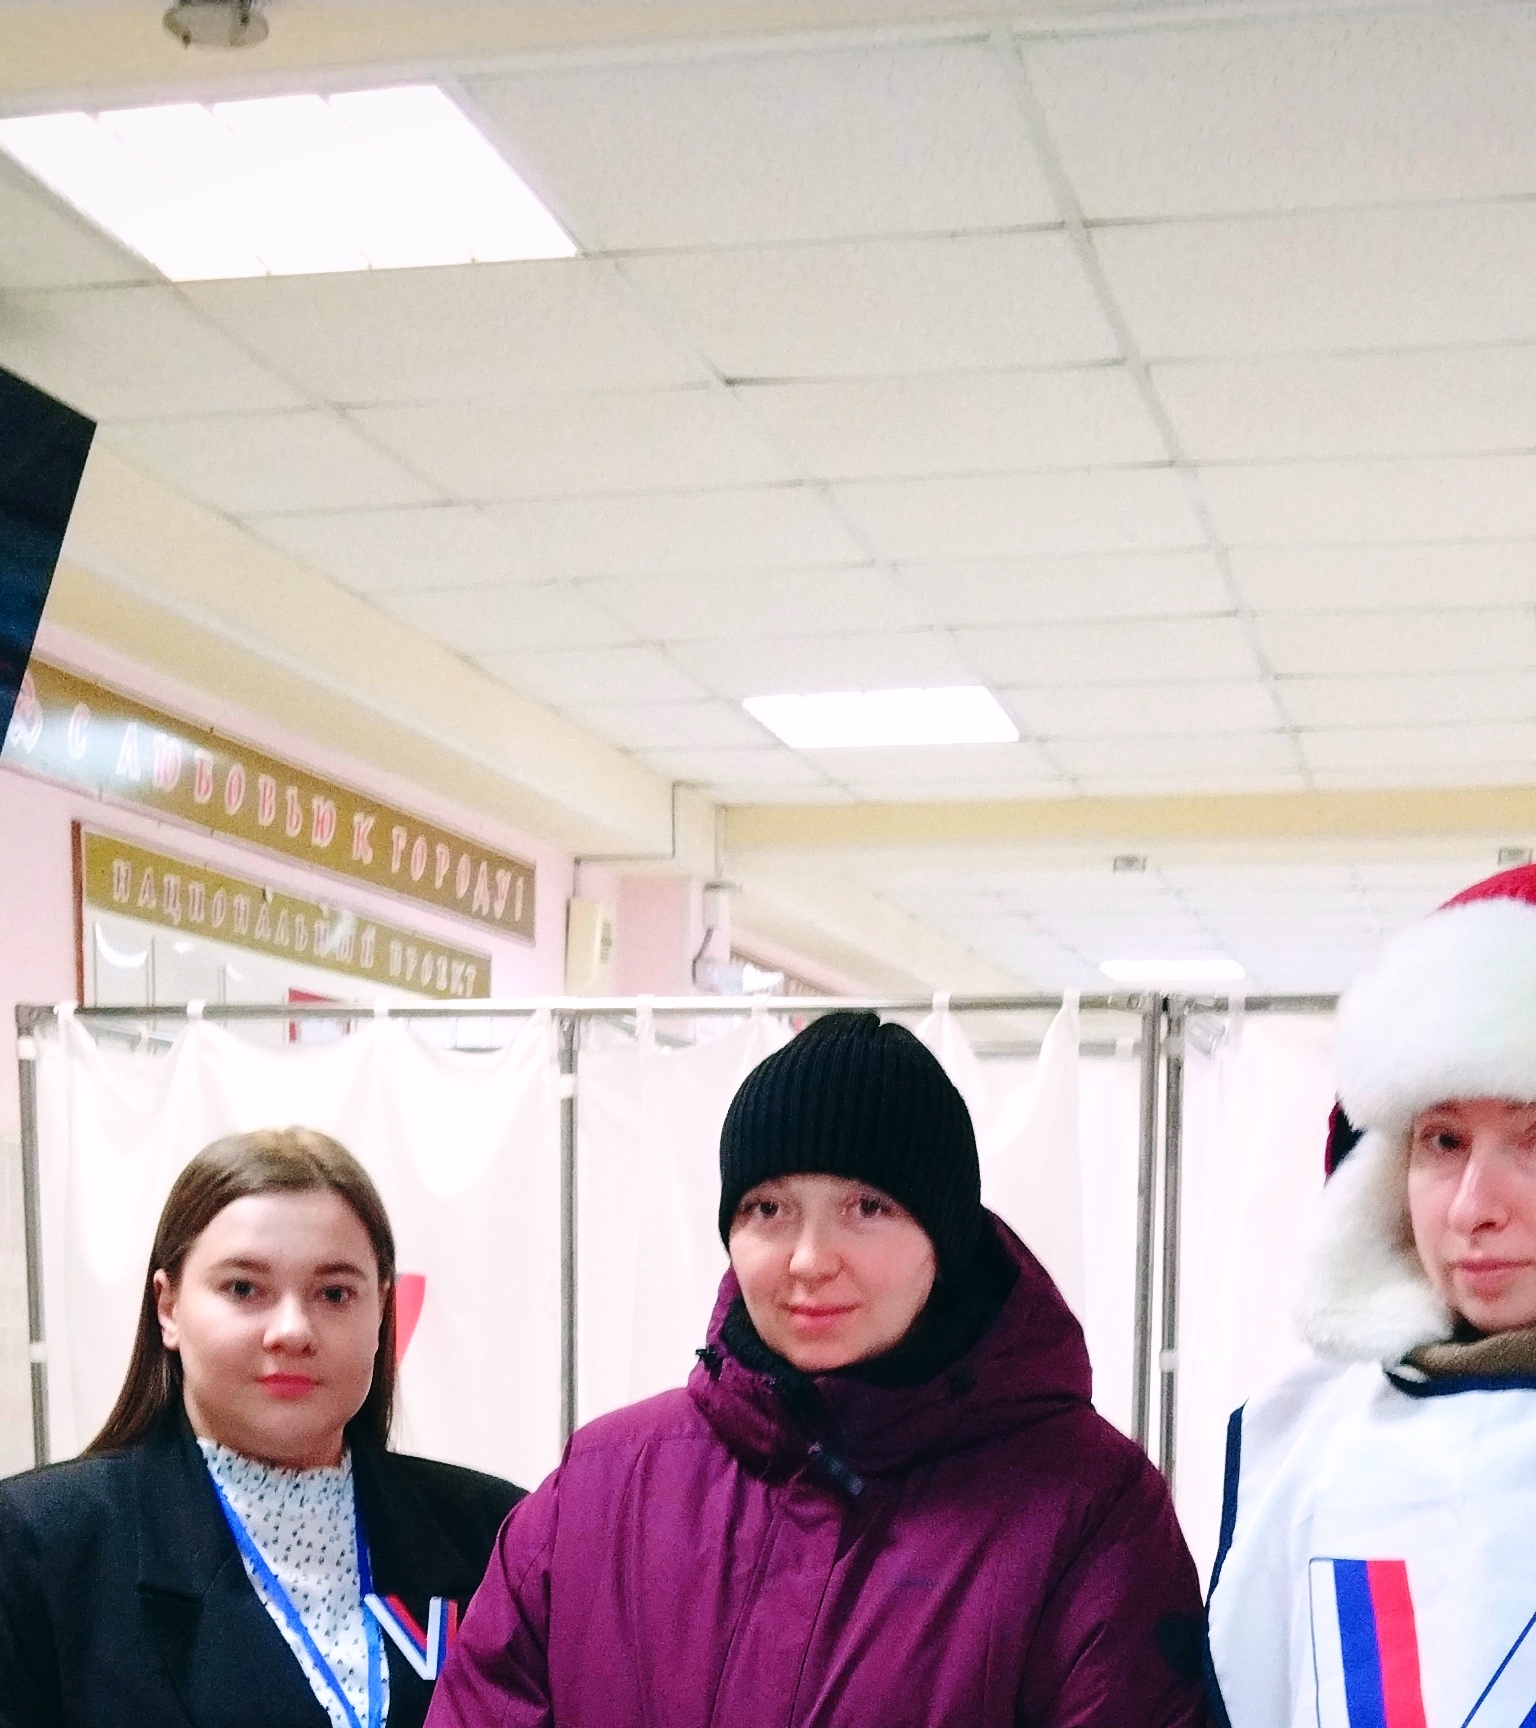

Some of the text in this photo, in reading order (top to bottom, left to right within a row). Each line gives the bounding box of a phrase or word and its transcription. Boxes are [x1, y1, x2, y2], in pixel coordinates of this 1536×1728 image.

[116, 721, 337, 848] ЛЮБОВЬЮ
[352, 811, 376, 866] К
[112, 857, 477, 999] НАЦИОНАЛЬНЫЙ ПРОЕКТ
